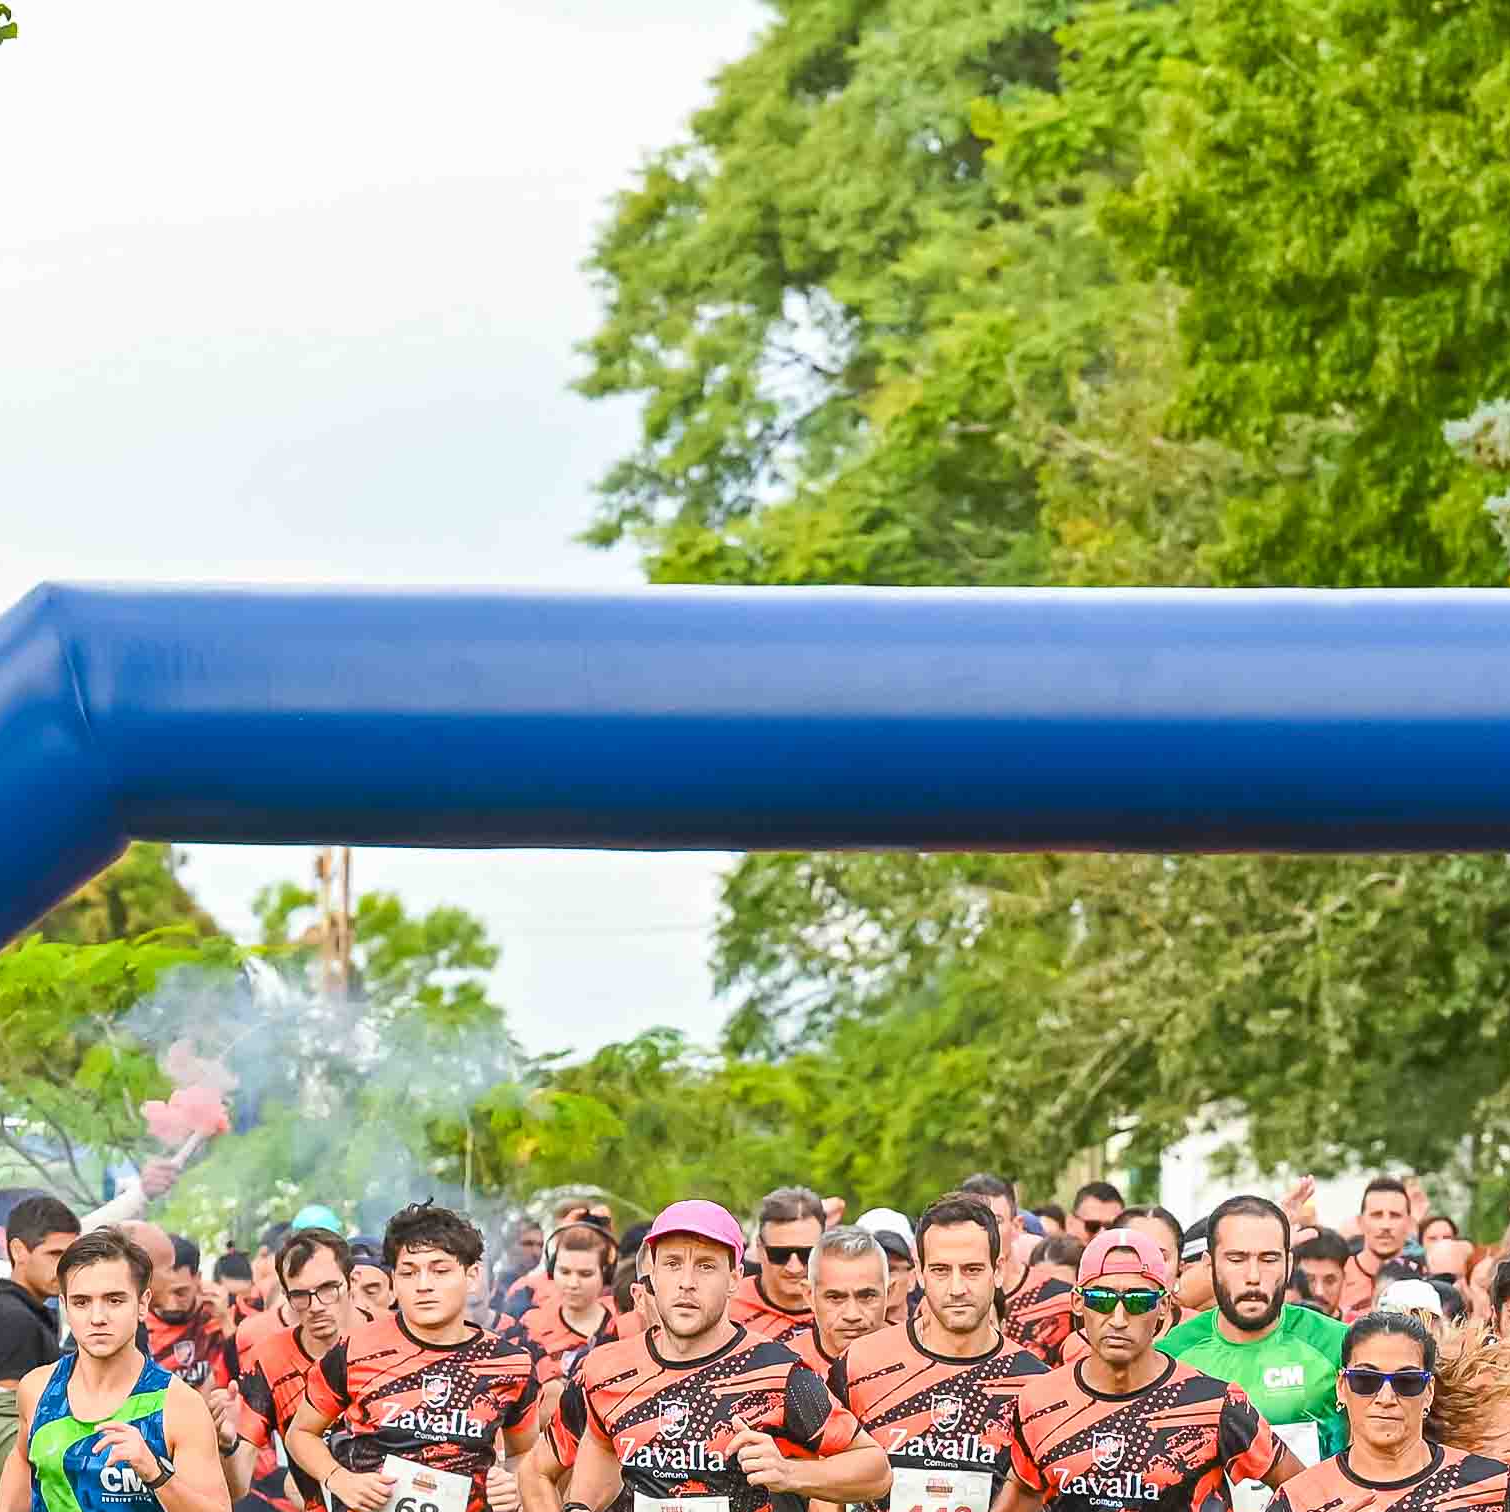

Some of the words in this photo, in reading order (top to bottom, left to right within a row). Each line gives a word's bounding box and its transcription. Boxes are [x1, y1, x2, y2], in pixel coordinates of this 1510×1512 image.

[1264, 1366, 1304, 1385] CM
[380, 1402, 483, 1438] Zavalla
[620, 1437, 726, 1472] Zavalla
[887, 1428, 996, 1463] Zavalla
[1053, 1468, 1160, 1500] Zavalla
